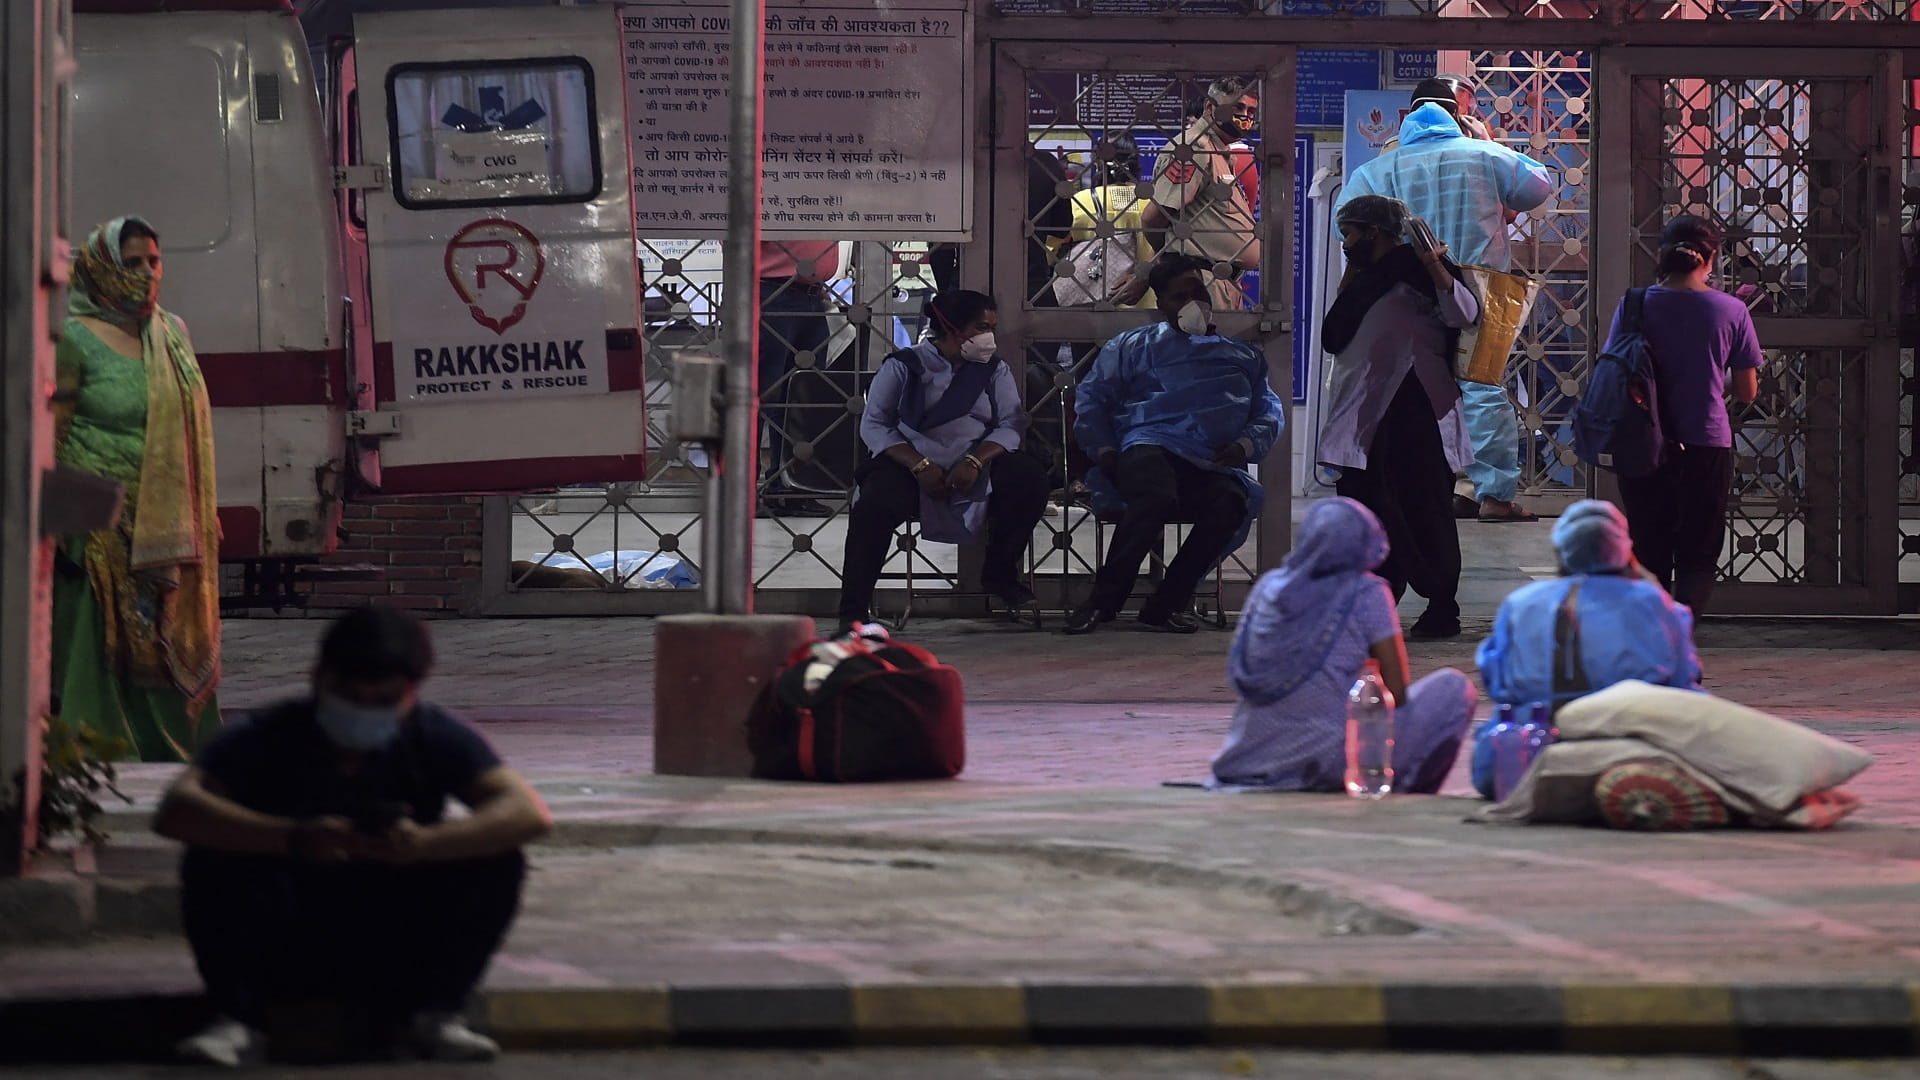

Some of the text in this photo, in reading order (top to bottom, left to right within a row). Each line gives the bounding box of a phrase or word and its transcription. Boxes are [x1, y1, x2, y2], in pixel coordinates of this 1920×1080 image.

[652, 13, 696, 30] आपको
[765, 14, 782, 31] की
[820, 15, 838, 32] की
[843, 20, 916, 33] आवश्यकता
[628, 38, 645, 51] यदि
[649, 40, 678, 51] आपको
[864, 45, 889, 54] लक्षण
[626, 54, 637, 65] तो
[641, 54, 671, 65] आपको
[674, 57, 714, 66] COVID-19
[1399, 54, 1422, 63] YOU
[628, 69, 645, 80] यदि
[649, 71, 679, 81] आपको
[683, 71, 717, 81] उपरोक्त
[1398, 67, 1422, 77] CCTV
[674, 88, 699, 96] लक्षण
[826, 90, 865, 99] COVID-19
[646, 99, 658, 111] की
[685, 100, 698, 111] की
[645, 117, 656, 126] या
[645, 132, 663, 142] आप
[667, 131, 690, 142] किसी
[694, 134, 727, 142] COVID-1
[770, 132, 795, 143] निकट
[484, 154, 517, 167] CWG
[645, 146, 659, 161] तो
[664, 150, 689, 161] आप
[840, 149, 873, 163] संपर्क
[647, 168, 677, 178] आपको
[681, 168, 715, 178] उपरोक्त
[782, 171, 800, 179] आप
[803, 171, 824, 180] ऊपर
[827, 169, 851, 180] लिखी
[647, 182, 658, 193] तो
[661, 184, 678, 195] फ्लू
[787, 195, 819, 208] सुरक्षित
[827, 211, 844, 223] होने
[847, 211, 860, 222] की
[864, 214, 893, 223] कामना
[896, 214, 922, 223] करता
[414, 340, 586, 378] RAKKSHAK
[417, 375, 588, 395] PROTECT & RESCUE
